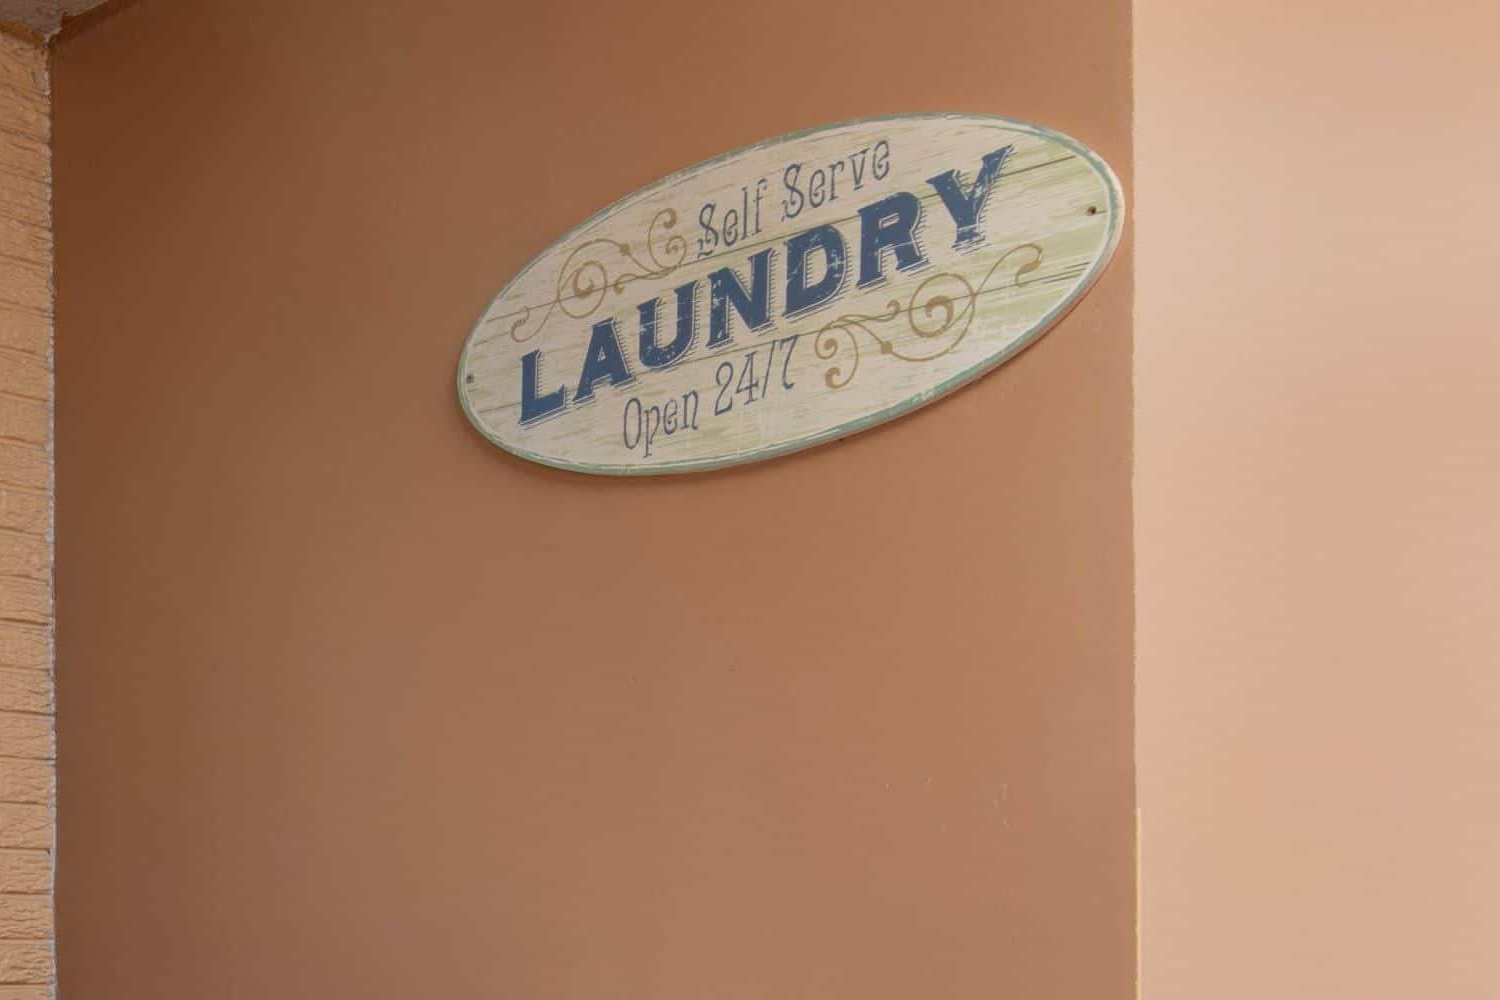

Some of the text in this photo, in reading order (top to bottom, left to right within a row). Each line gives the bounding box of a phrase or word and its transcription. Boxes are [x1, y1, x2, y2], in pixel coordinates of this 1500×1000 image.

[697, 140, 891, 256] Self Serve
[518, 144, 1017, 427] LAUNDRY
[623, 335, 799, 458] Open 24/7
